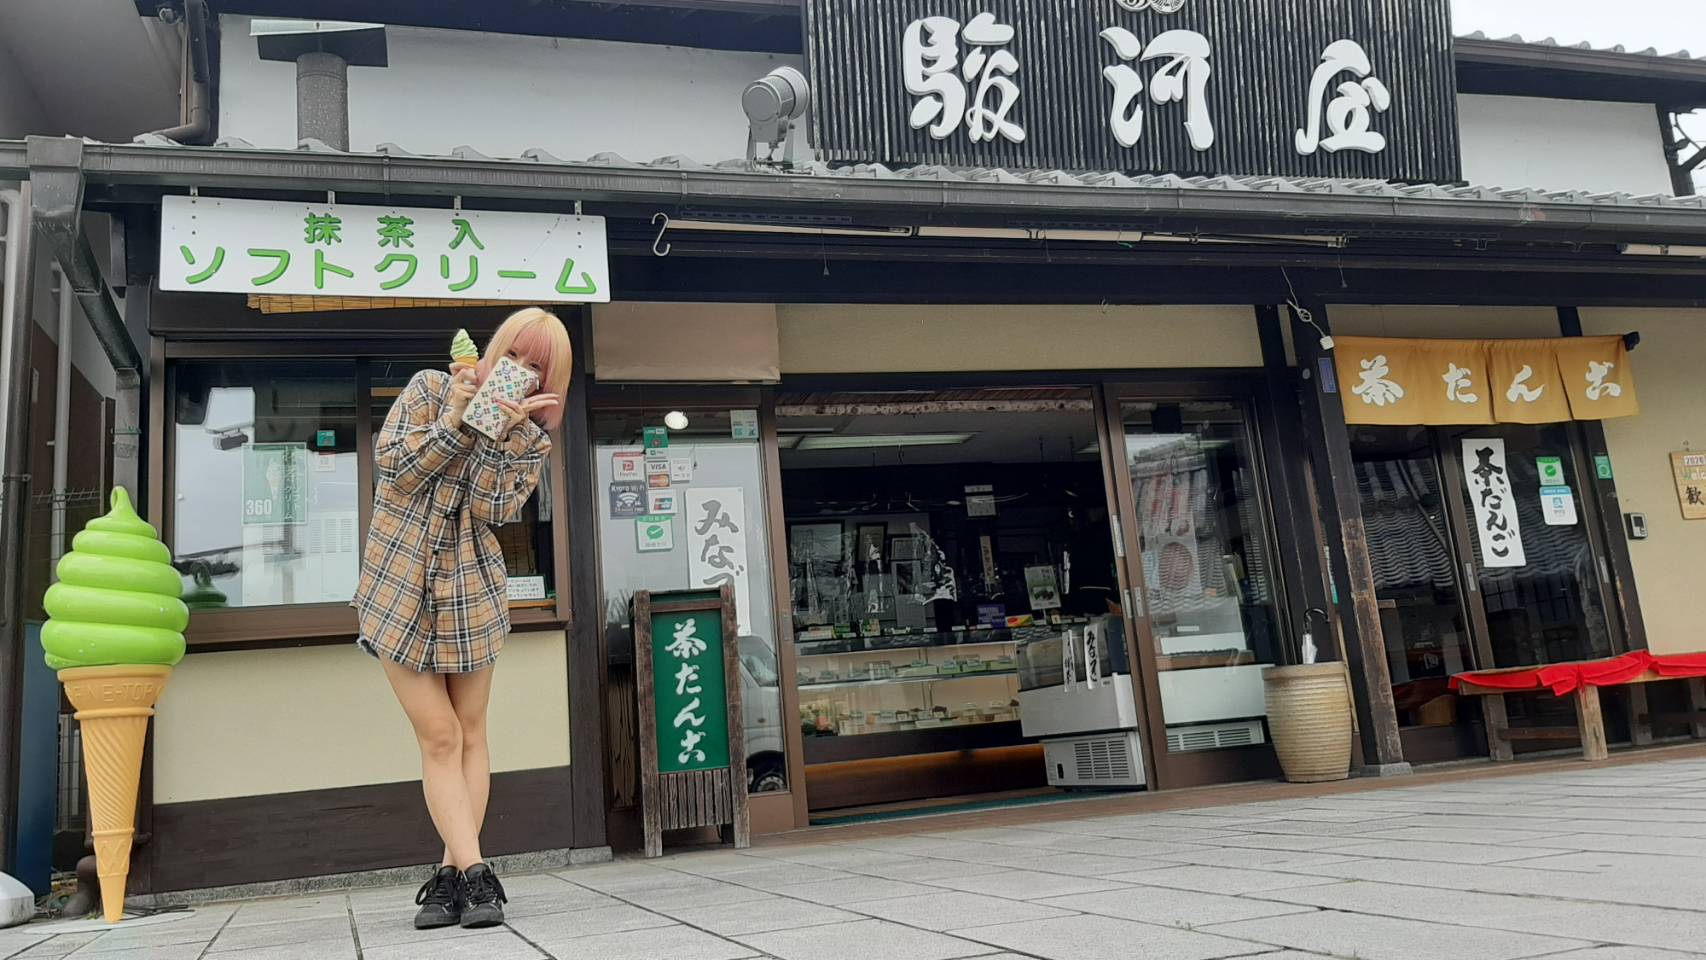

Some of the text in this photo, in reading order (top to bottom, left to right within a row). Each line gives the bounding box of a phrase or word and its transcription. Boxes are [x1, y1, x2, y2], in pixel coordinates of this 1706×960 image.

[304, 214, 484, 250] 抹茶入
[179, 243, 597, 296] ソフトクリーム
[245, 499, 273, 516] 360
[1472, 447, 1516, 558] 茶だんご
